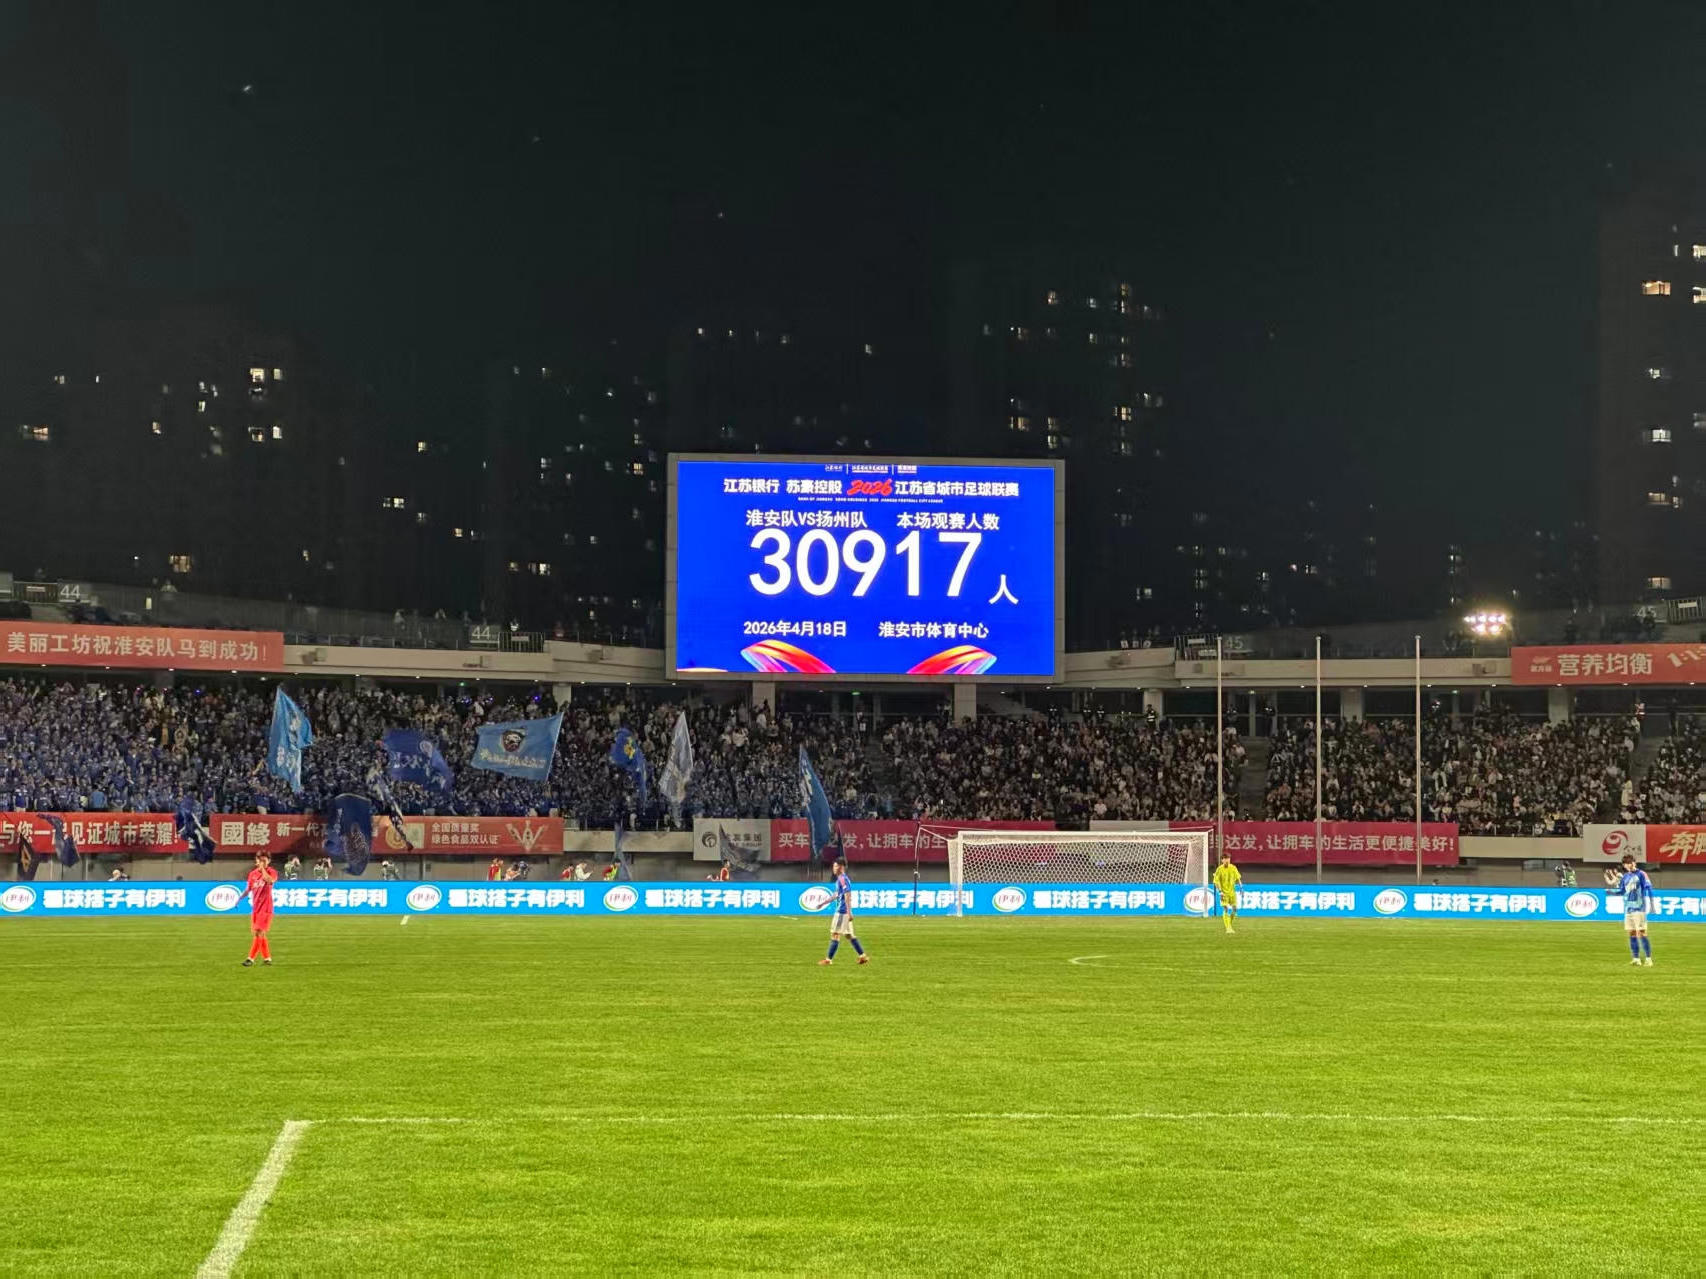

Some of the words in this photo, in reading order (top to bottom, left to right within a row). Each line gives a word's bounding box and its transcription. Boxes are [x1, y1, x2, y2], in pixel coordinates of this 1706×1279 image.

[723, 478, 780, 494] 江苏银行
[786, 479, 843, 495] 苏豪控股
[846, 479, 893, 497] 2026
[894, 480, 1020, 497] 江苏省城市足球联赛
[745, 508, 868, 529] 淮安队VS扬州队
[896, 511, 1001, 531] 本场观赛人数
[748, 527, 984, 598] 30917
[988, 574, 1019, 605] 人
[60, 584, 81, 599] 44
[471, 626, 491, 640] 44
[743, 620, 847, 637] 2026年4月18日
[878, 621, 990, 638] 淮安市体育中心
[7, 631, 267, 662] 美丽工坊祝淮安队马到成功！
[1225, 636, 1244, 649] 45
[1557, 653, 1653, 677] 营养均衡
[778, 832, 947, 849] 买车达发，让拥车的生
[43, 889, 186, 908] 看球搭子有伊利
[271, 889, 388, 908] 球搭子有伊利
[448, 889, 585, 908] 看球搭子有伊利
[645, 889, 780, 908] 看球搭子有伊利
[1033, 890, 1165, 909] 看球搭子有伊利
[1413, 892, 1546, 912] 看球搭子有伊利
